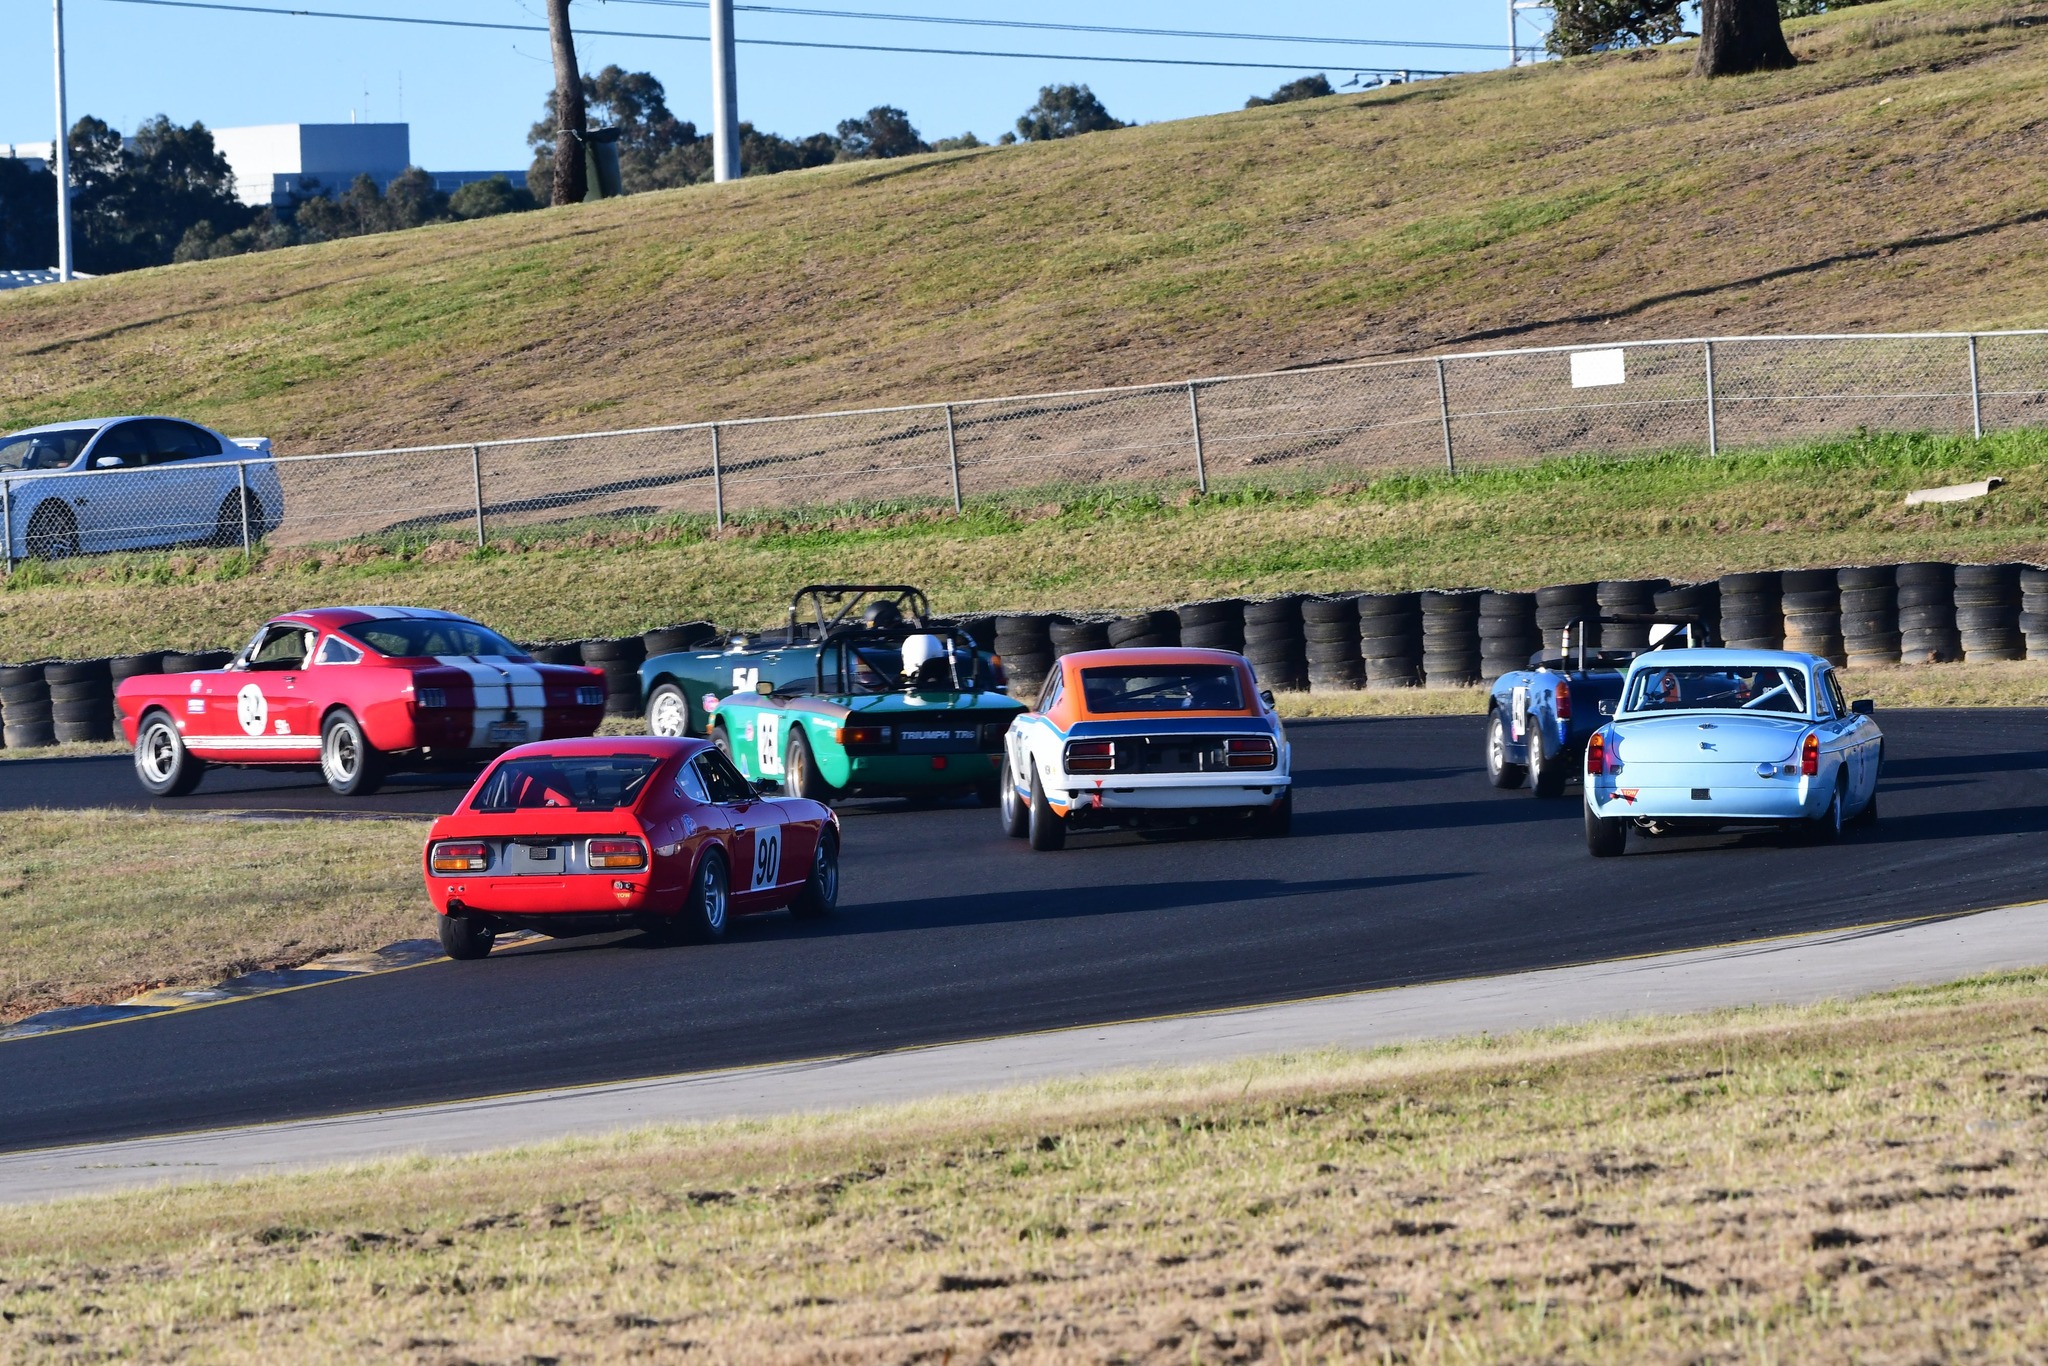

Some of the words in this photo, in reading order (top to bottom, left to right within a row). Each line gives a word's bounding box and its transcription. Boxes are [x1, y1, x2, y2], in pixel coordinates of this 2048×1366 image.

[901, 730, 951, 740] TRIUMPH
[954, 730, 976, 739] TR6
[756, 835, 778, 886] 90
